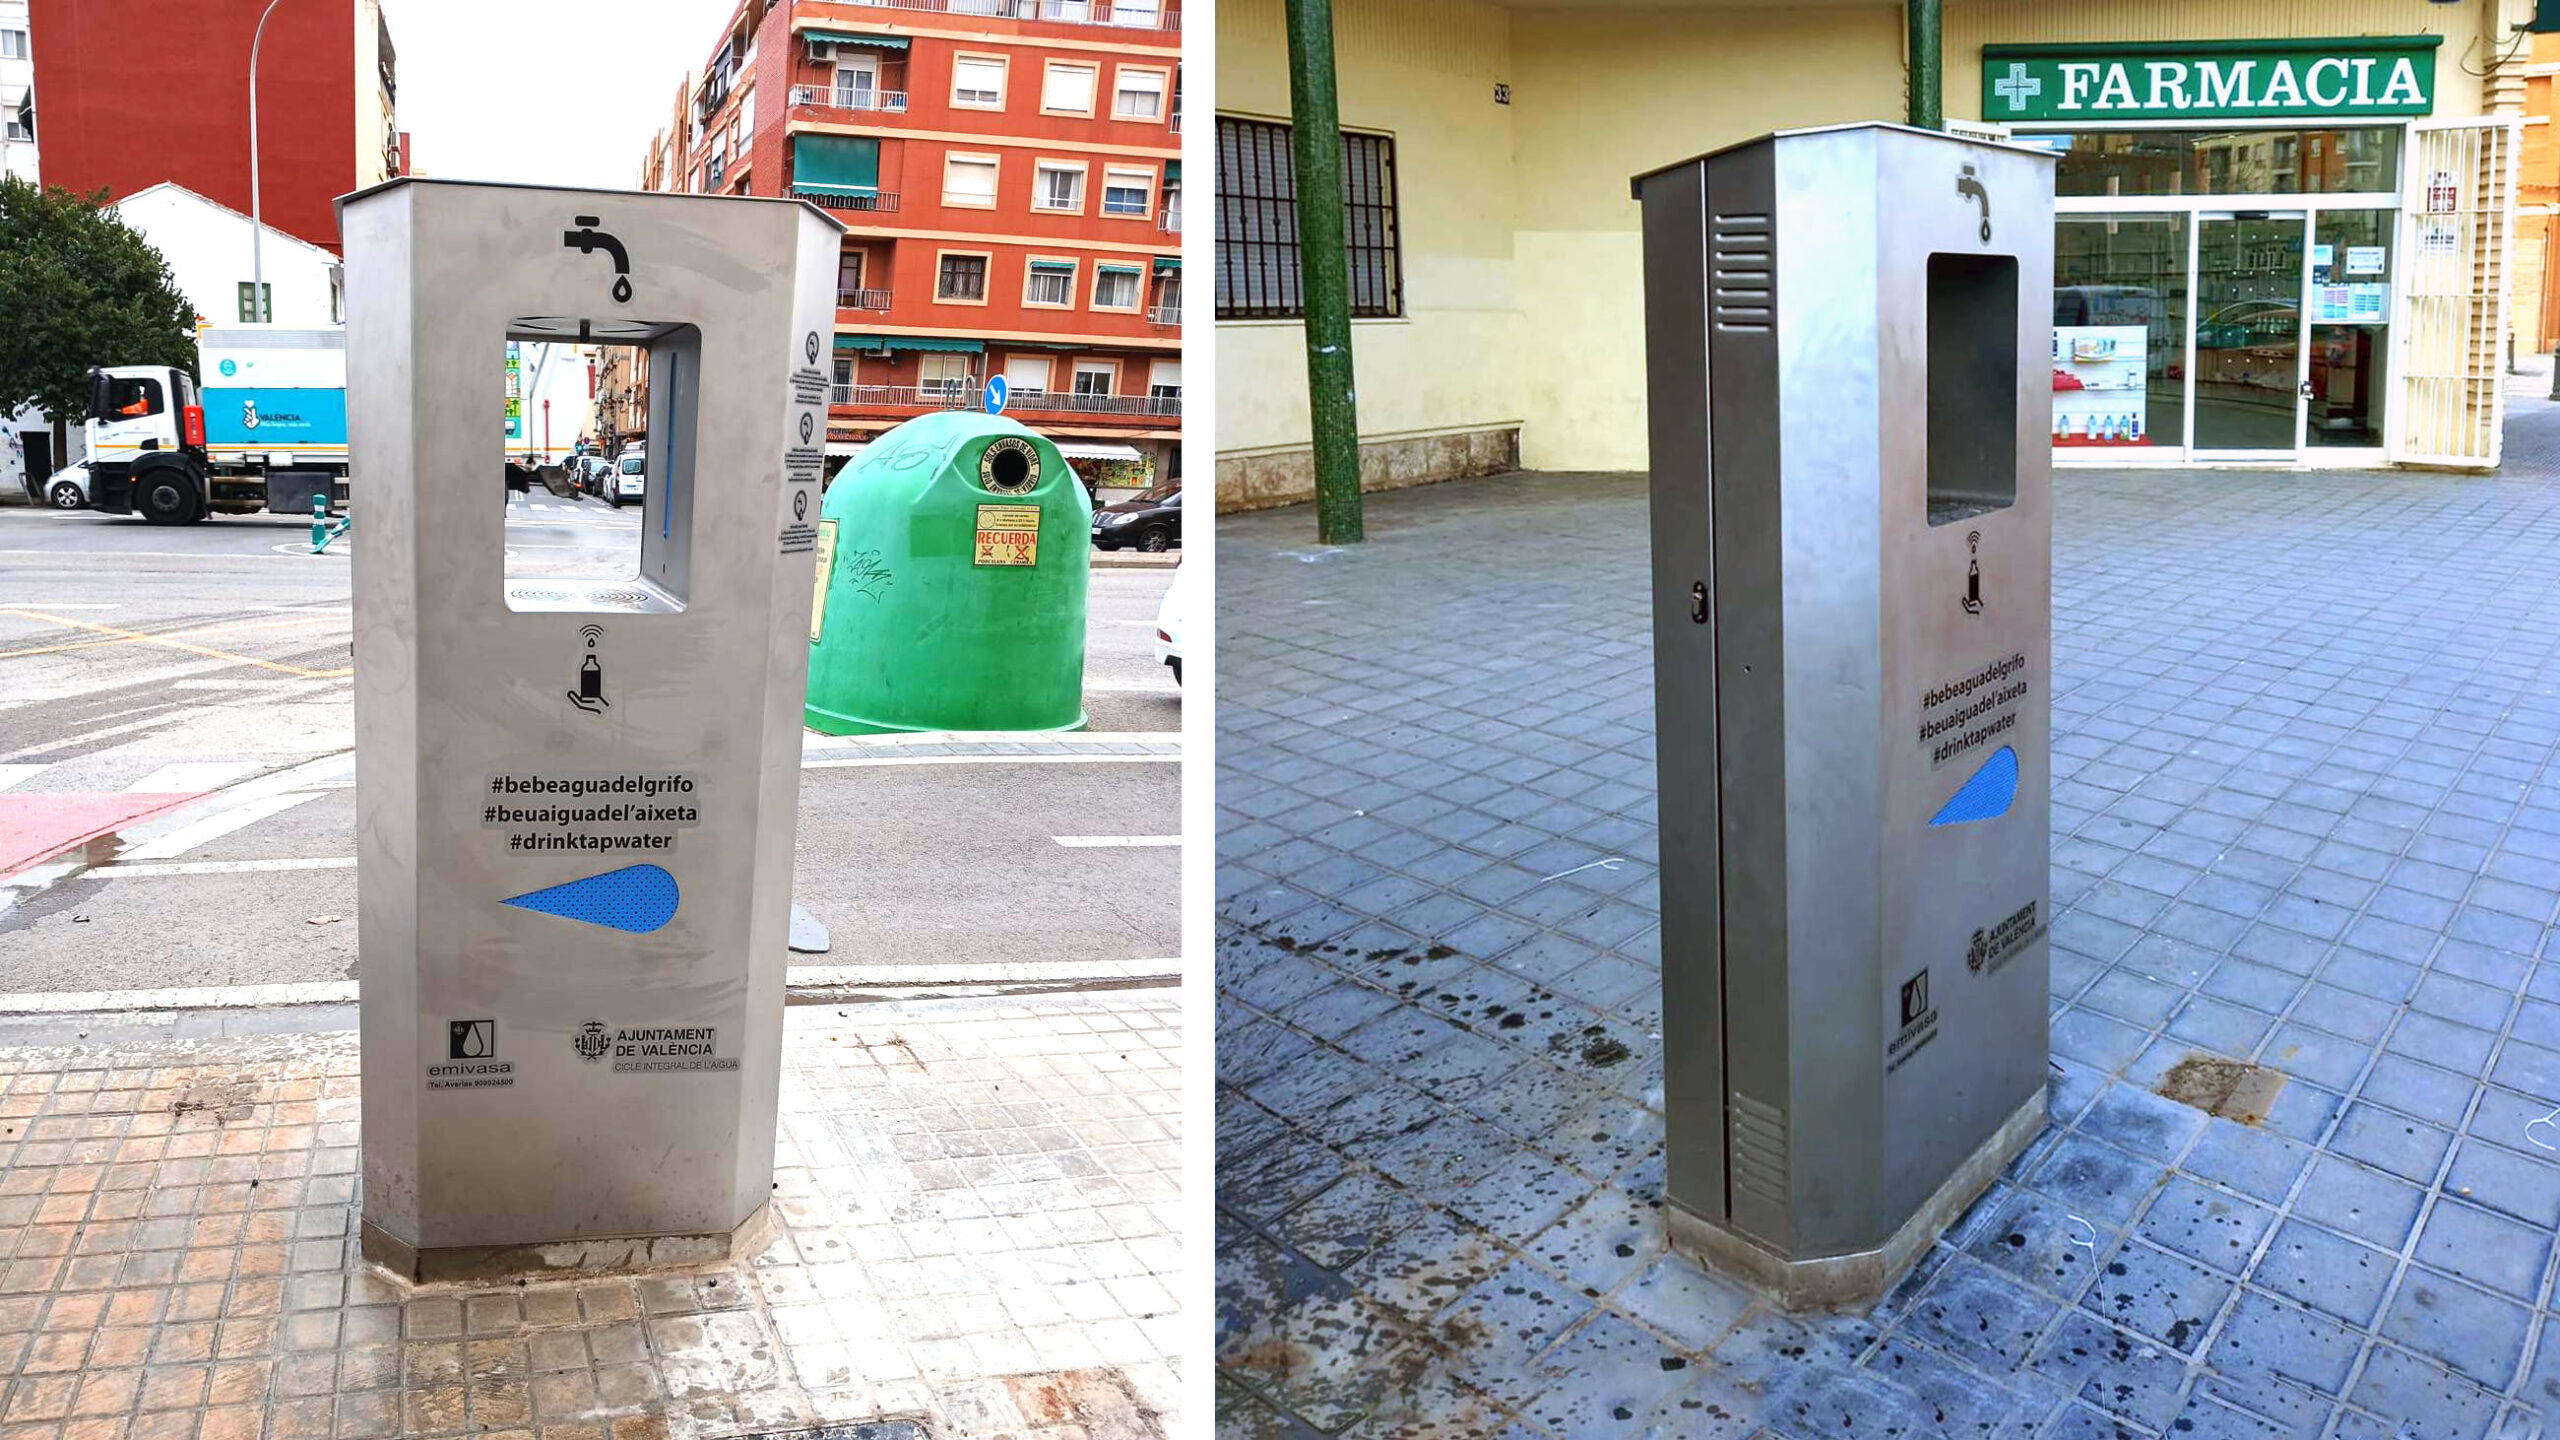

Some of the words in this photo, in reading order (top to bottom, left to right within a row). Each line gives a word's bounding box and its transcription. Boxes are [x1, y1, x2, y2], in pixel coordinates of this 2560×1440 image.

[2057, 57, 2427, 110] FARMACIA
[1496, 84, 1509, 103] 33
[994, 439, 1020, 452] ENVASOS
[1019, 442, 1029, 453] DE
[977, 531, 1036, 545] RECUERDA
[1923, 653, 2025, 711] #bebeaguadelgrifo
[1933, 713, 2016, 764] #drinktapwater
[491, 775, 694, 798] #bebeaguadelgrifo
[510, 832, 672, 853] #drinktapwater
[617, 1028, 714, 1041] AJUNTAMENT
[1888, 1009, 1938, 1055] emivasa
[616, 1045, 635, 1056] DE
[641, 1042, 713, 1056] VALÈNCIA
[429, 1063, 511, 1076] emivasa
[614, 1063, 641, 1071] CICLE
[643, 1062, 687, 1071] INTEGRAL
[689, 1061, 701, 1070] DE
